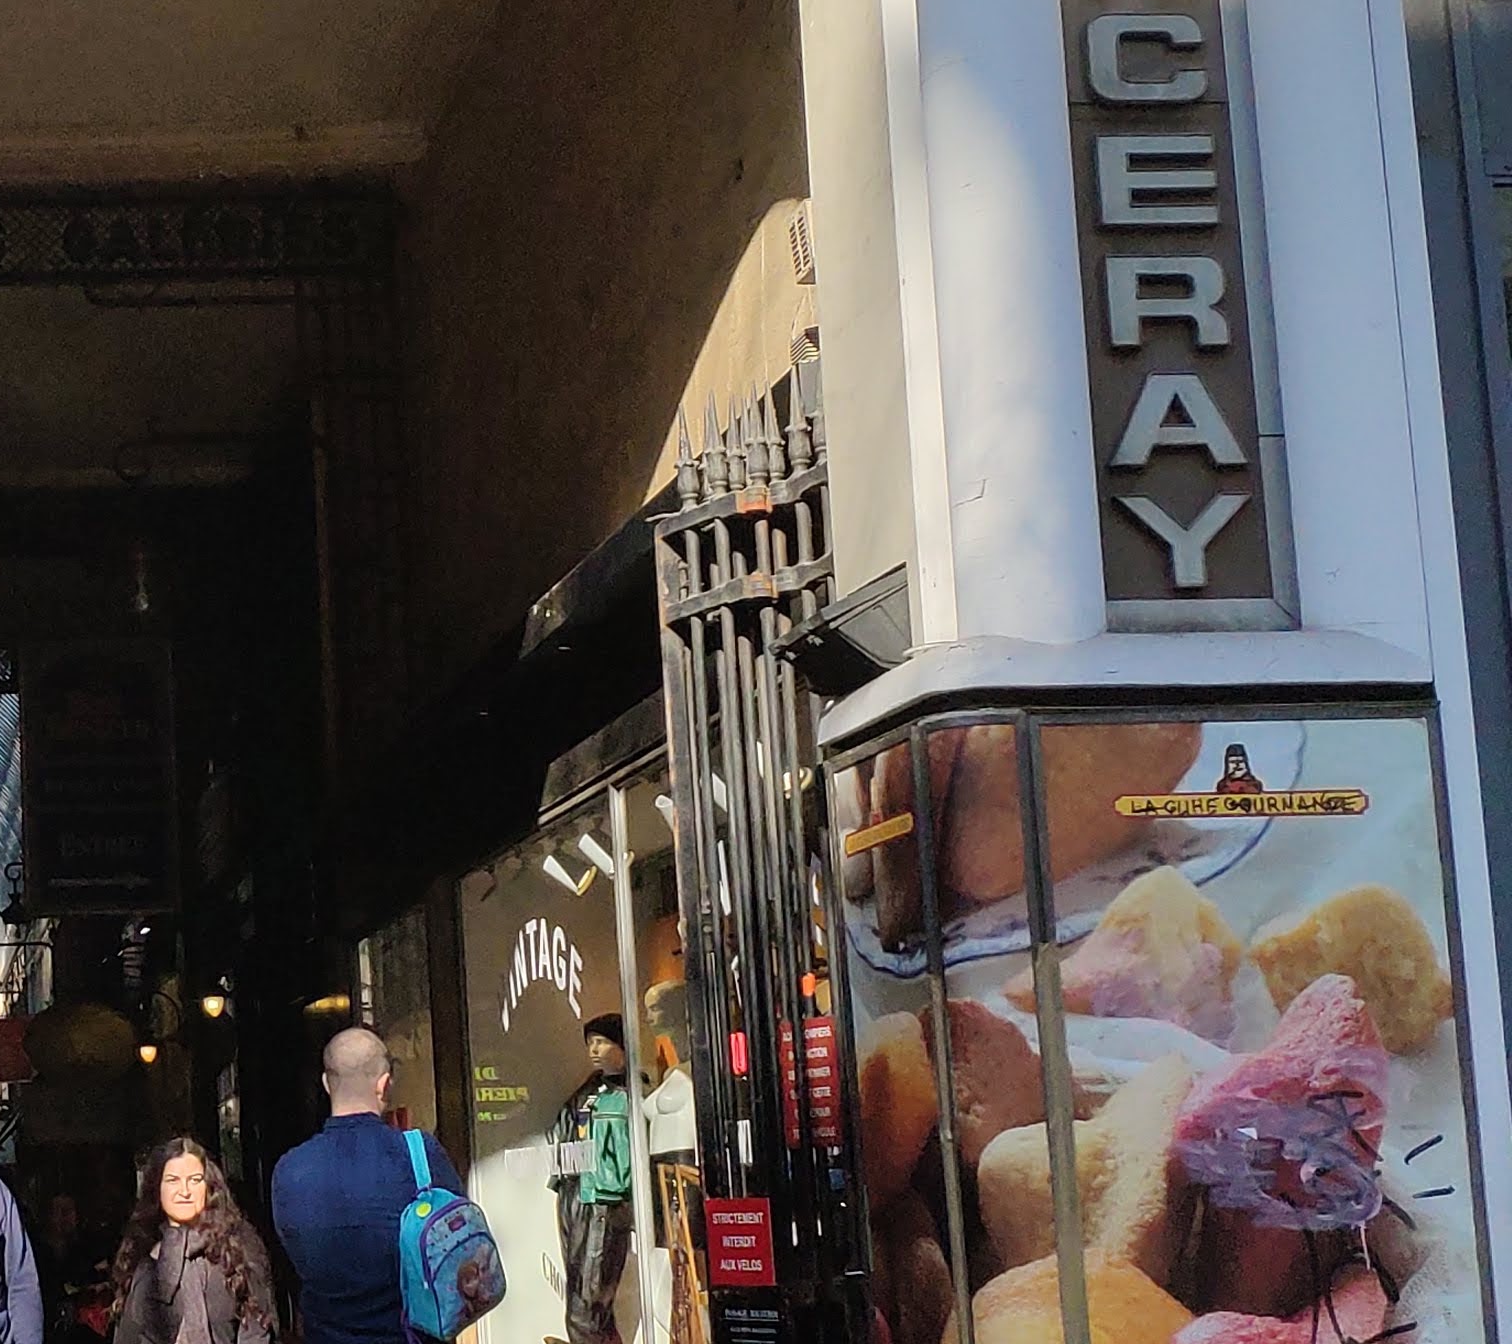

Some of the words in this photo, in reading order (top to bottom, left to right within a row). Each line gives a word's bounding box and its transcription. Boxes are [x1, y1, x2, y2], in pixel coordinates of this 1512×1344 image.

[712, 1212, 765, 1225] STRICTEMENT
[722, 1235, 757, 1248] INTERDIT
[719, 1259, 738, 1272] AUX
[738, 1259, 764, 1273] VELOS
